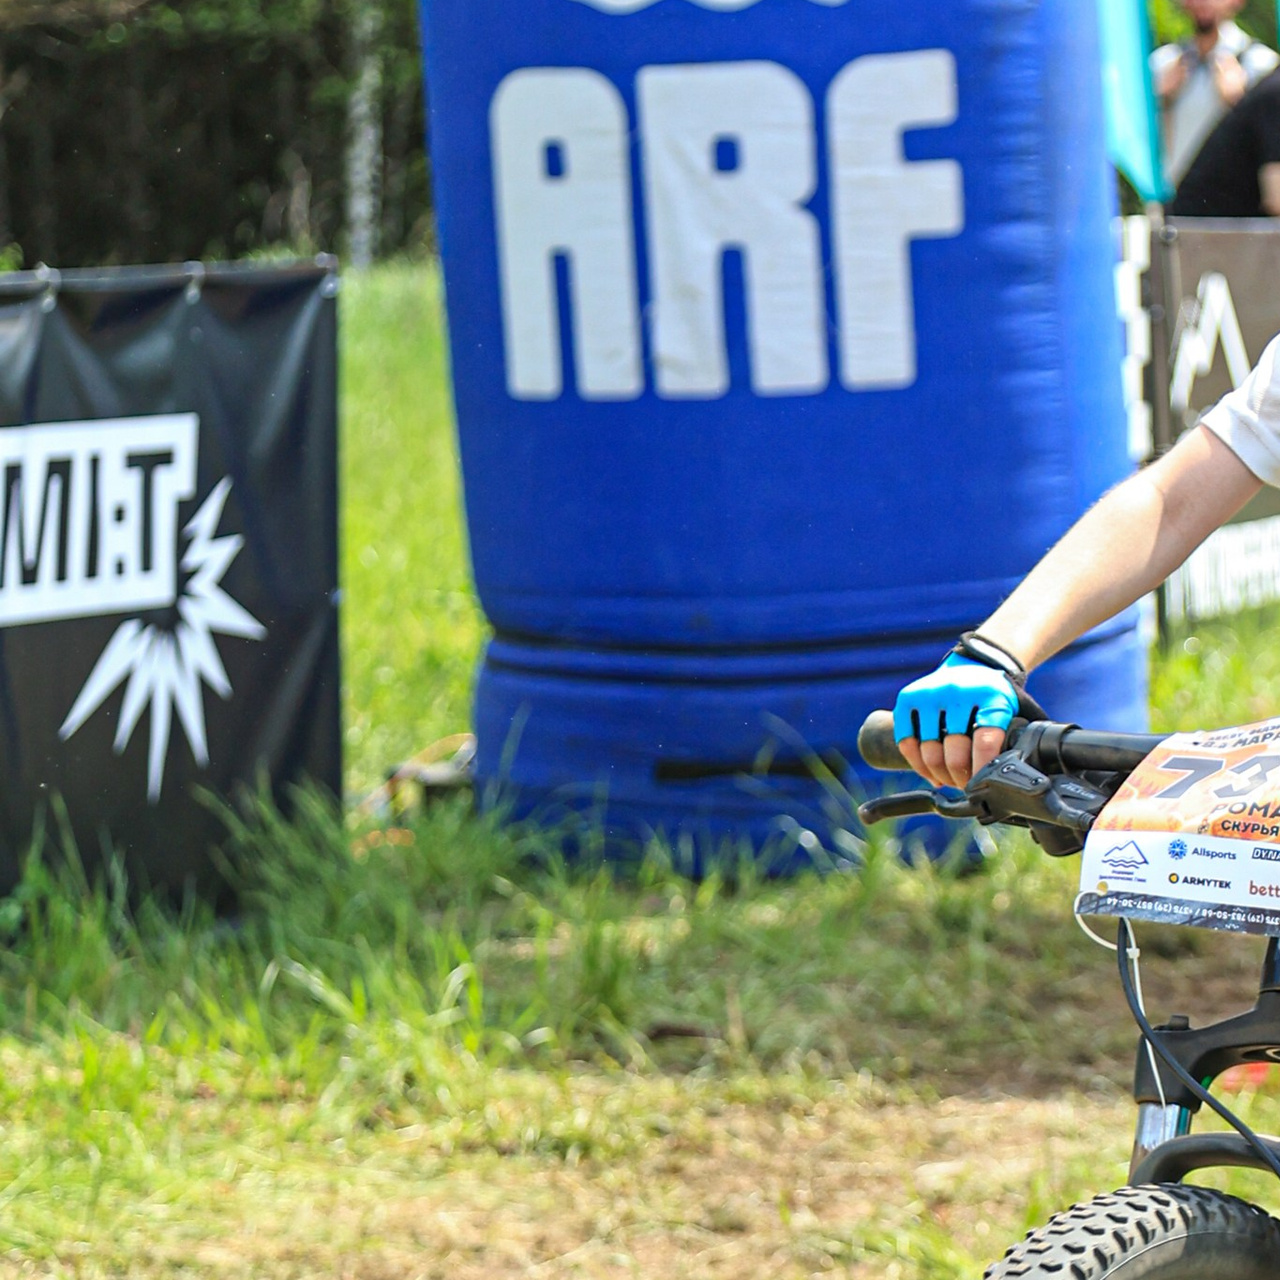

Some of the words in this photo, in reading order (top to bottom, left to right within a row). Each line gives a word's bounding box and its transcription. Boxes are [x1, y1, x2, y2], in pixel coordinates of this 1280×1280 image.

[489, 47, 965, 402] ARF
[1192, 847, 1237, 860] Allsports
[1182, 876, 1231, 889] ARMYTEK
[1154, 901, 1172, 913] (29)
[1247, 913, 1265, 924] (29)
